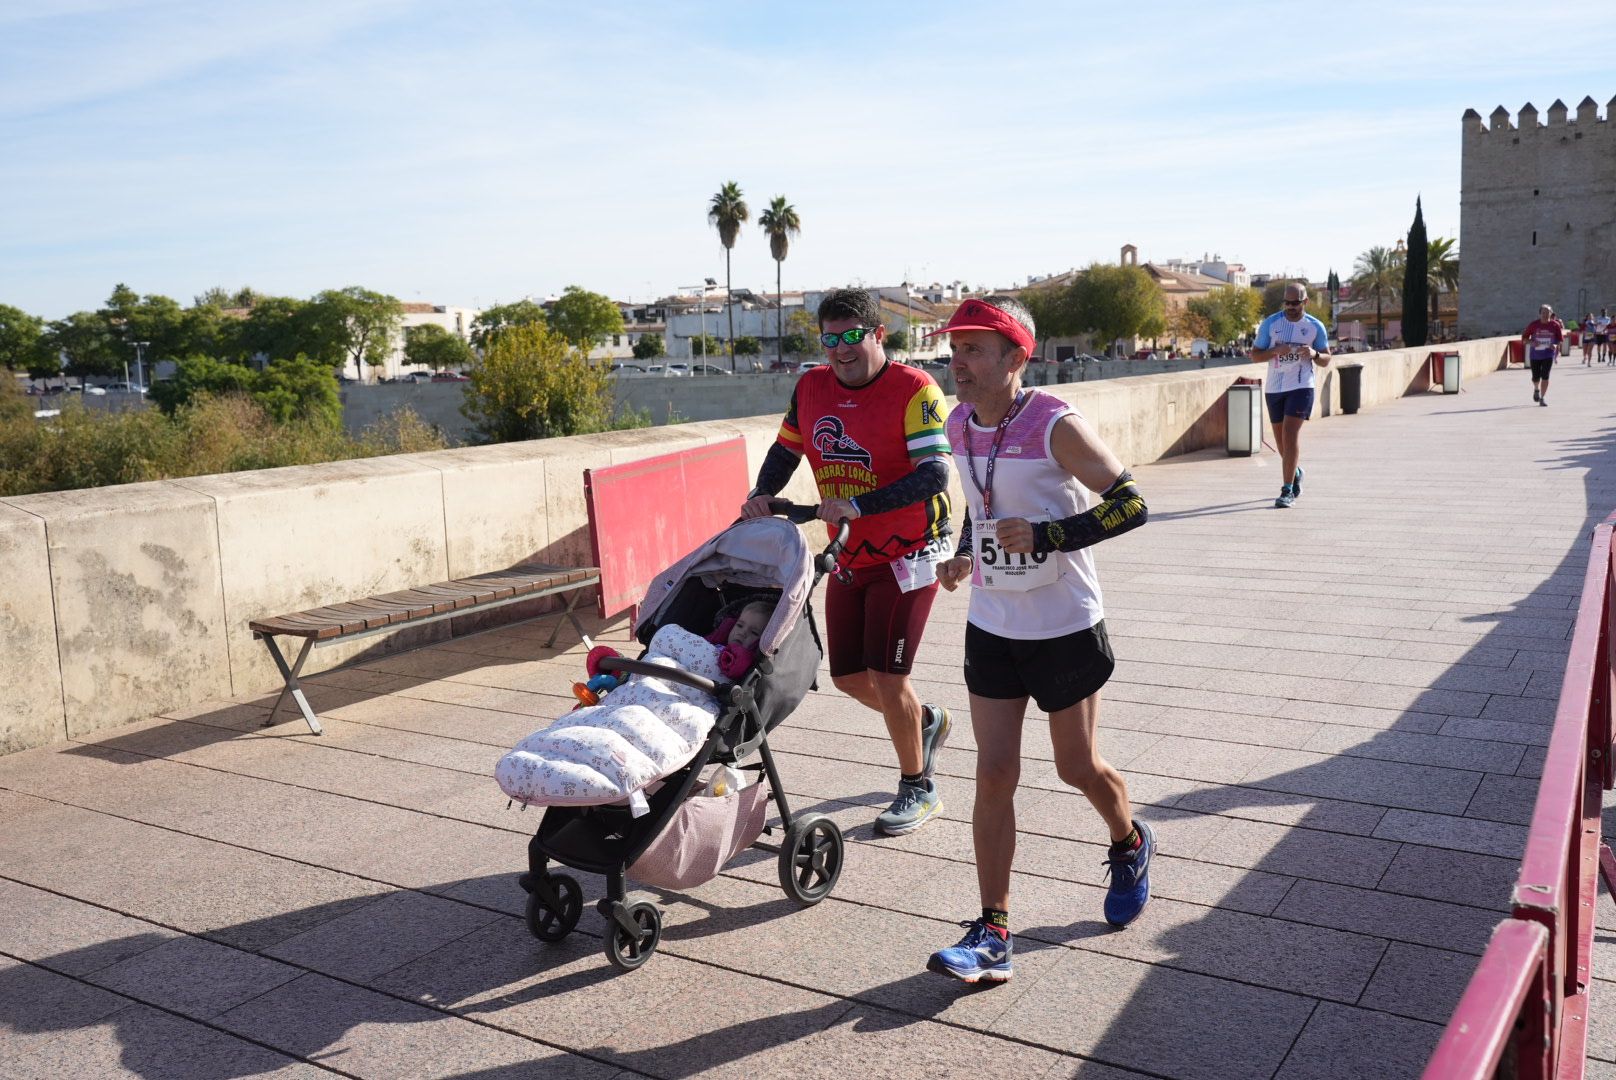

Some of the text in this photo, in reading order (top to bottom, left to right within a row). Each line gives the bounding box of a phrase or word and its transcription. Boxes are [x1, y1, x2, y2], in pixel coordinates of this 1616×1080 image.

[815, 464, 878, 487] KABRAS LOKAS
[1101, 508, 1126, 531] TRAIL
[895, 638, 905, 664] Joma
